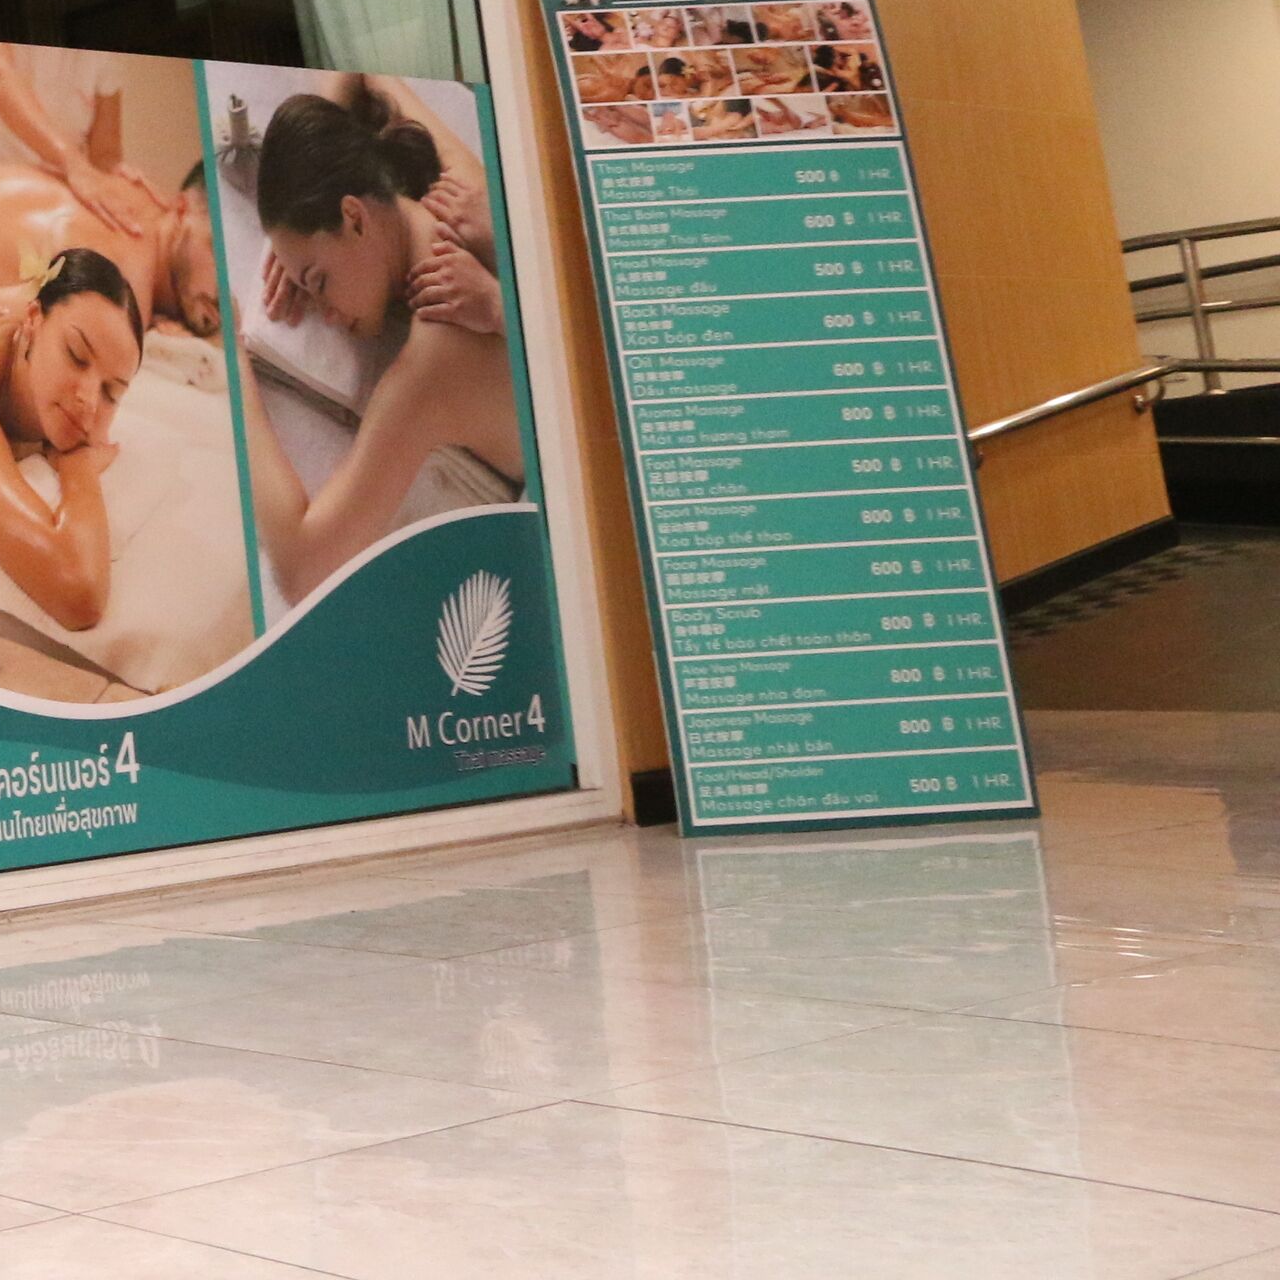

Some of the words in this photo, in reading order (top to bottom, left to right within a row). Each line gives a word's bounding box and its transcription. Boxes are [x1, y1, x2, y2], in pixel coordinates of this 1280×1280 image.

[631, 162, 694, 174] Massage
[651, 256, 709, 268] Massage
[814, 262, 845, 276] 500
[615, 285, 684, 297] Massage
[622, 306, 657, 319] Back
[661, 303, 730, 317] Massage
[659, 356, 725, 368] Massage
[684, 405, 745, 417] Massage
[678, 456, 743, 469] Massage
[852, 458, 883, 473] 500
[694, 505, 757, 517] Massage
[663, 559, 697, 571] Face
[701, 557, 768, 569] Massage
[871, 561, 902, 575] 600
[667, 587, 737, 600] Massage
[671, 610, 712, 623] Body
[716, 607, 762, 620] Scrub
[740, 661, 792, 672] Massage
[686, 692, 755, 705] Massage
[407, 714, 432, 750] M
[438, 711, 523, 746] Corner
[527, 694, 547, 733] 4
[688, 715, 753, 729] Japanese
[754, 712, 814, 725] Massage
[115, 731, 140, 784] 4
[691, 745, 763, 759] Massage
[910, 779, 941, 793] 500
[701, 798, 774, 812] Massage
